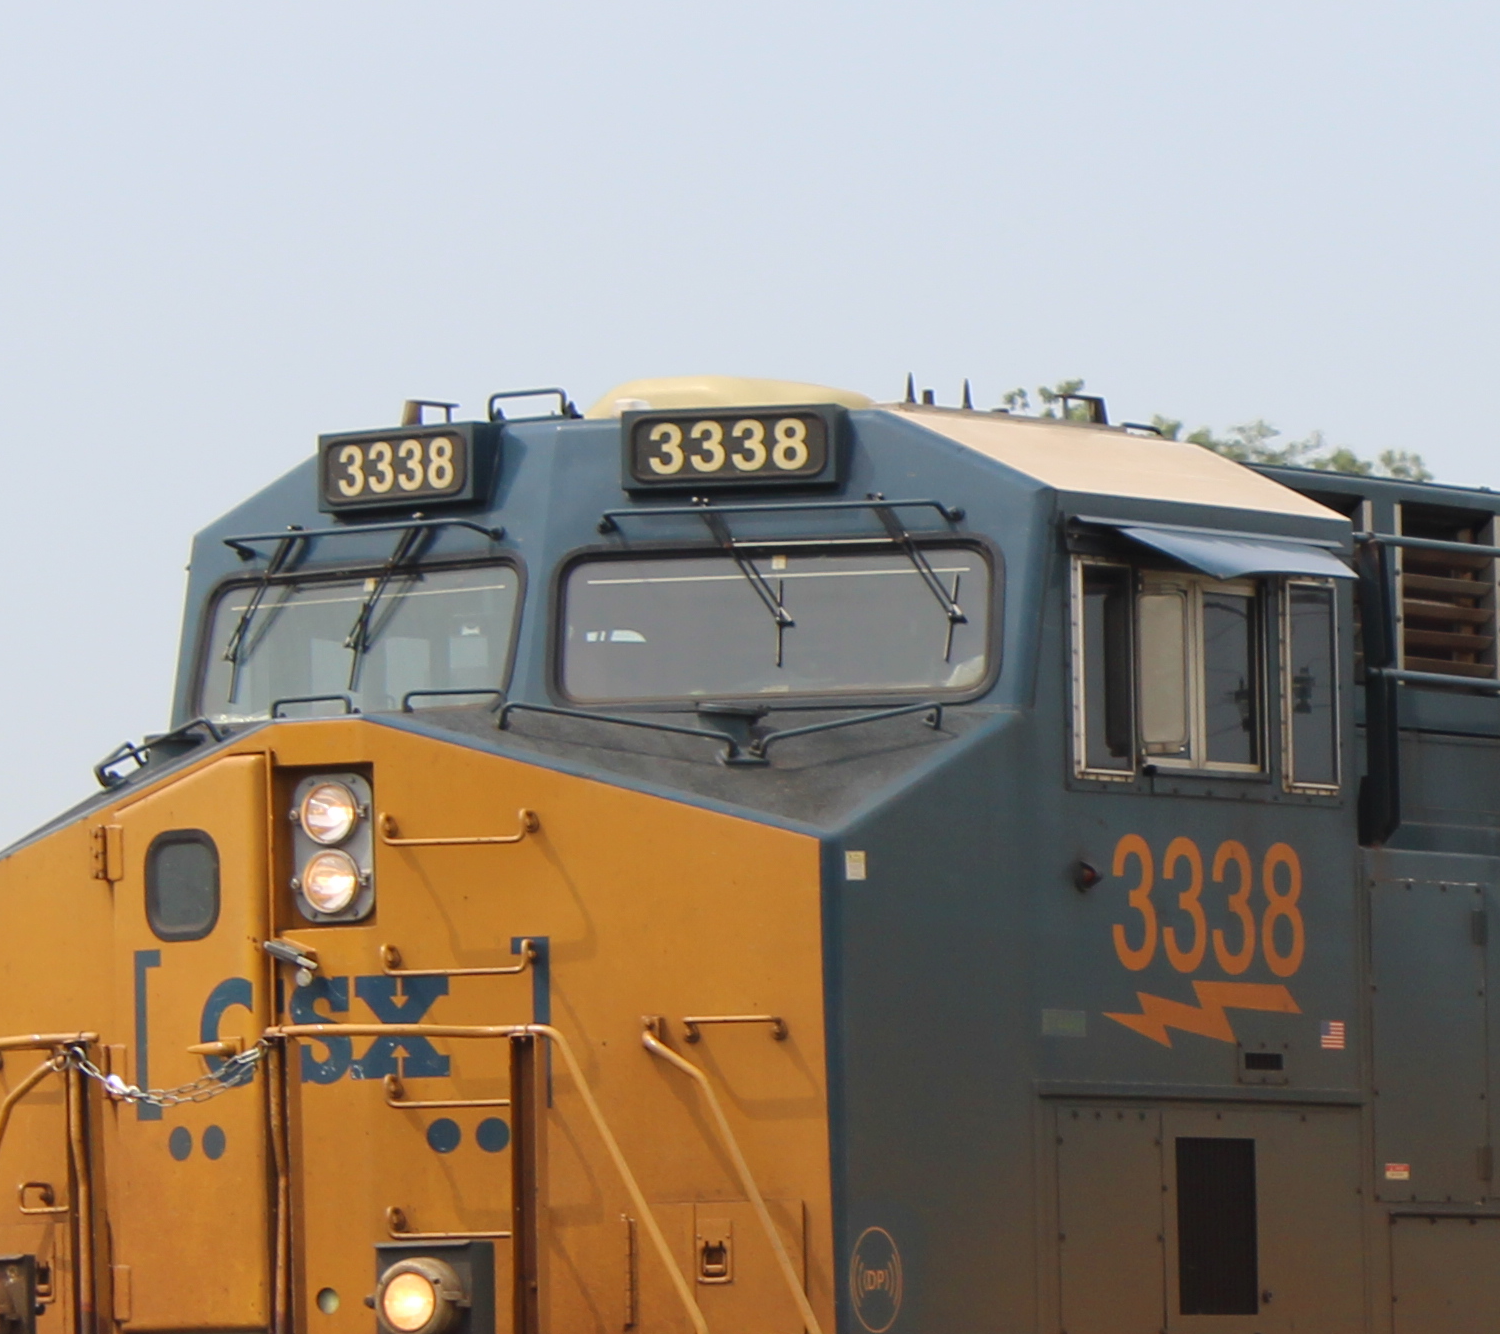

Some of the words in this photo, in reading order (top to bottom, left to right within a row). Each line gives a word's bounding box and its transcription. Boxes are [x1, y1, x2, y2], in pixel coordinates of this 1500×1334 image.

[337, 436, 455, 497] 3338
[648, 417, 810, 475] 3338
[1112, 833, 1305, 978] 3338
